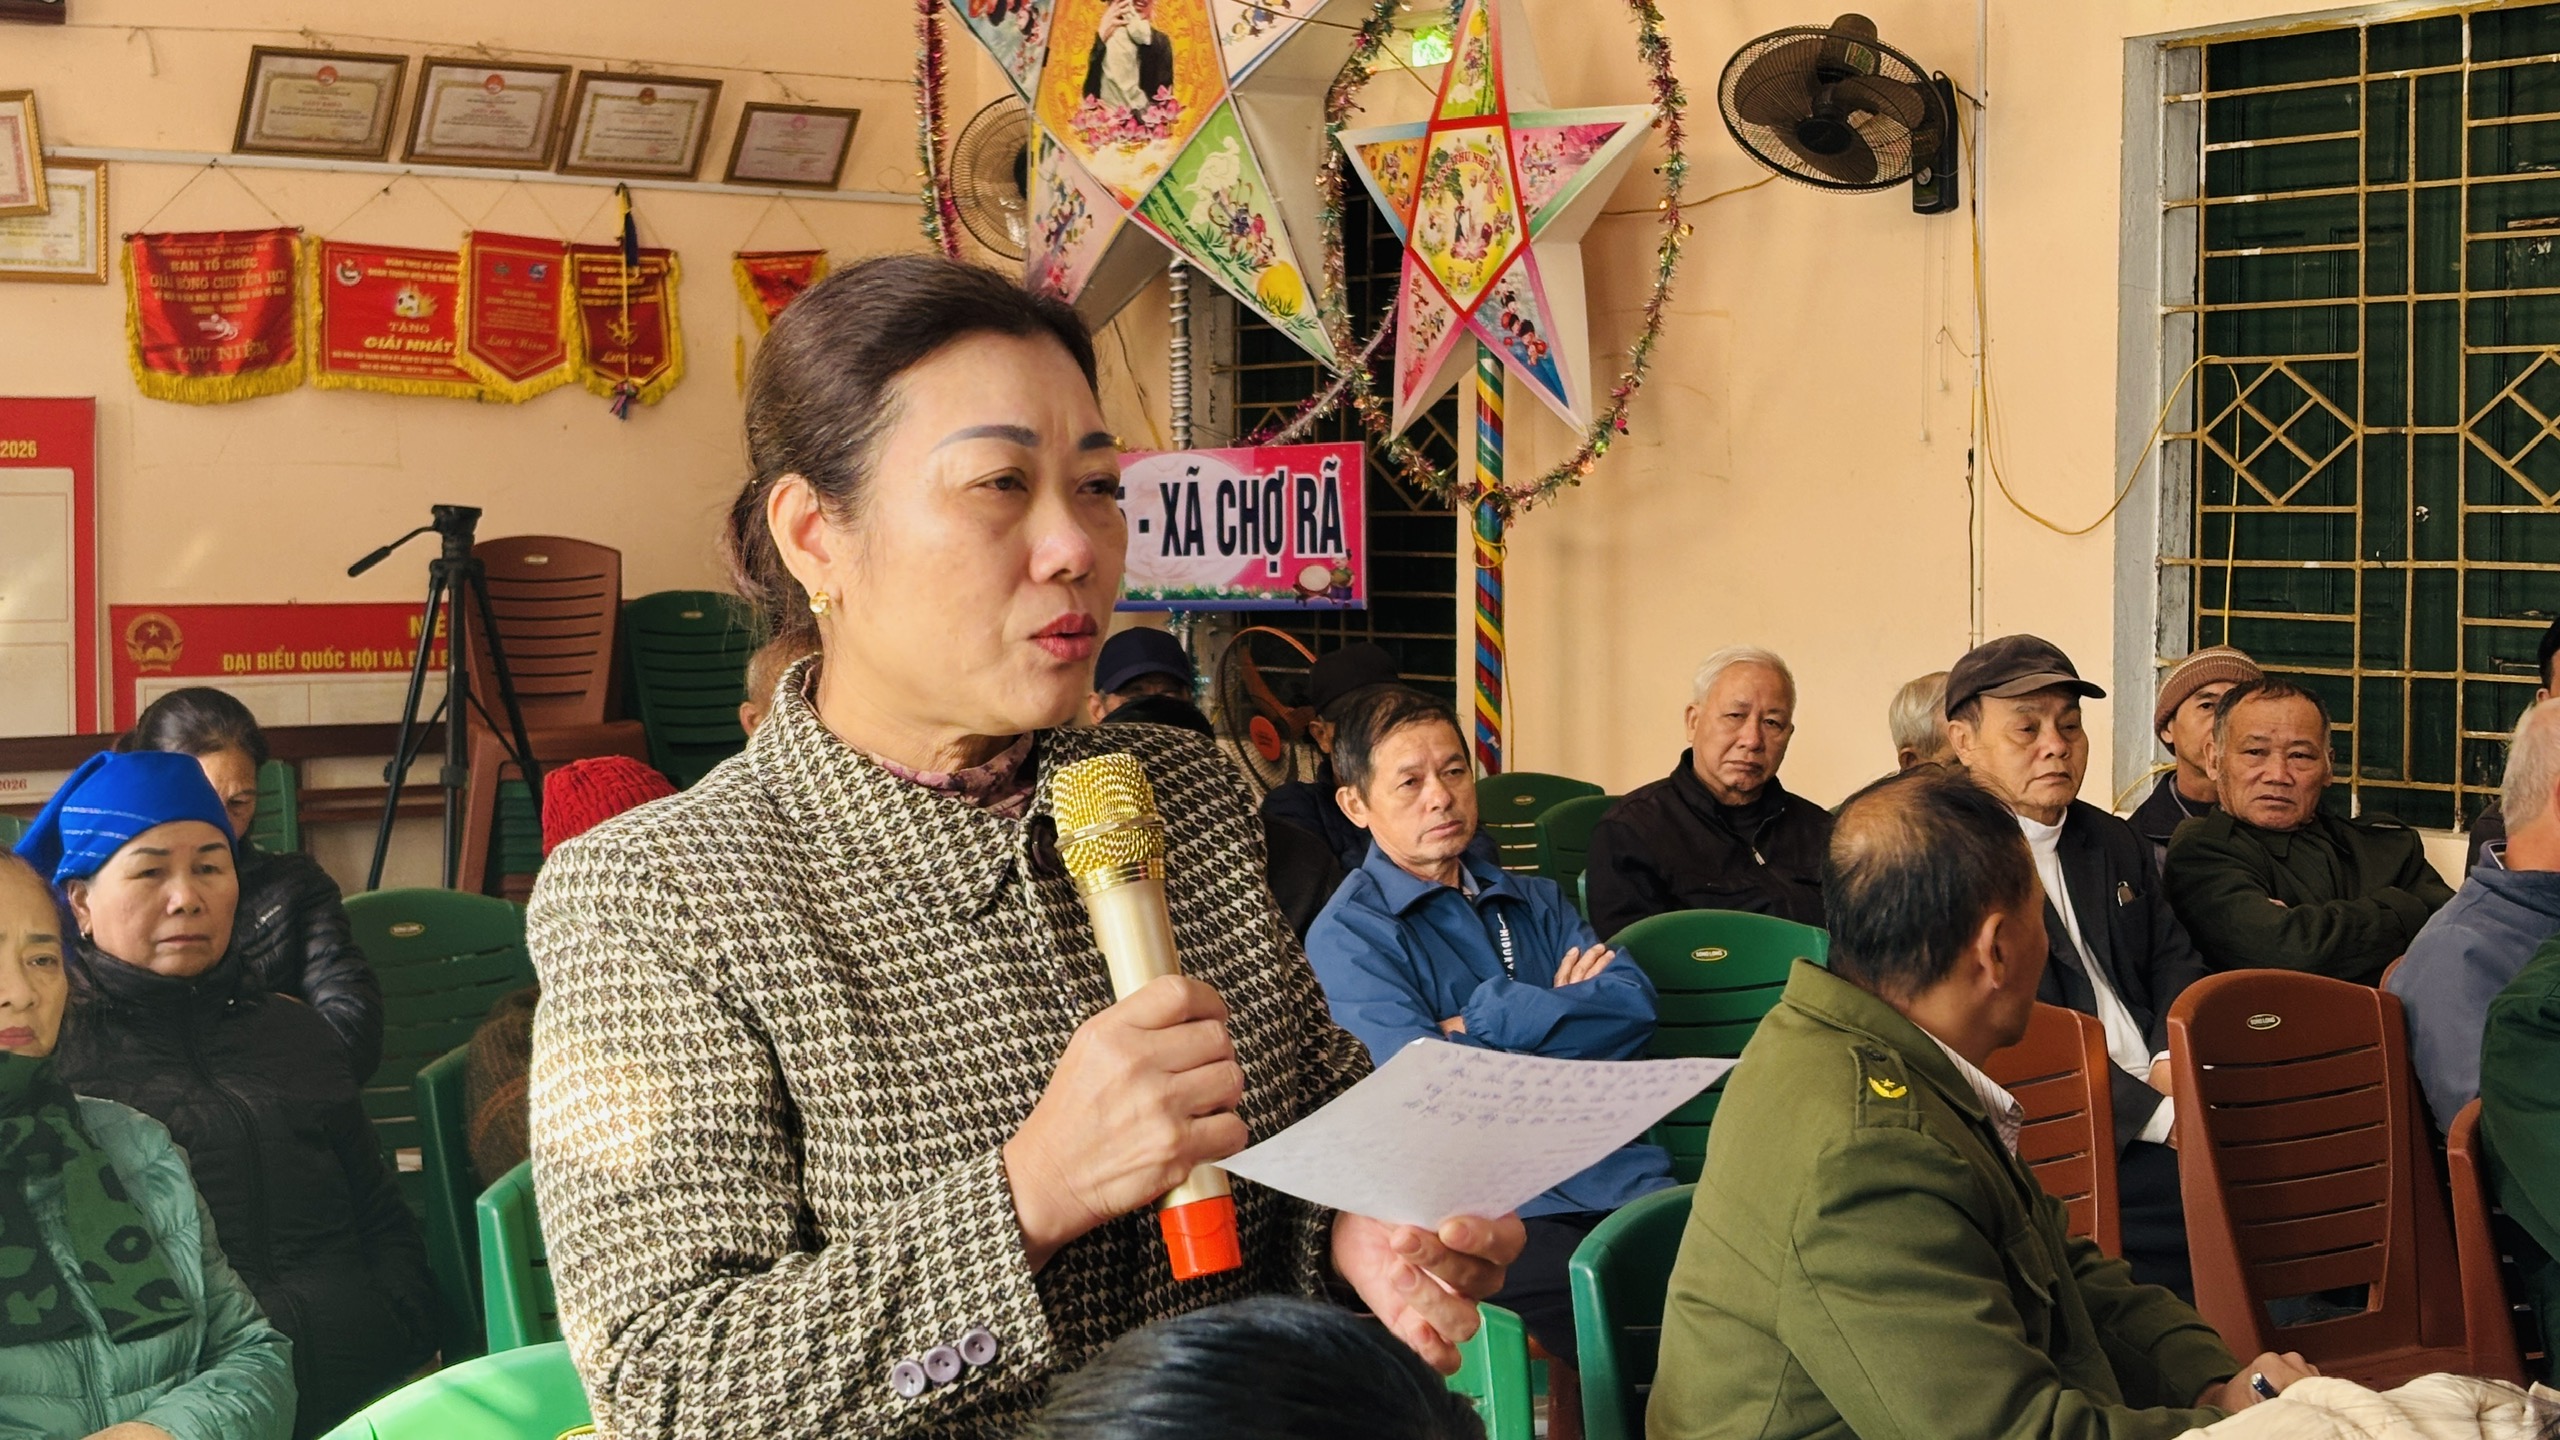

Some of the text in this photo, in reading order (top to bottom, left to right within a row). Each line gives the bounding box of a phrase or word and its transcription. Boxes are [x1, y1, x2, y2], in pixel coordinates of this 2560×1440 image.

[171, 260, 199, 272] BAN
[224, 255, 259, 269] CHỨC
[364, 334, 455, 354] GIẢI NHẤT
[0, 440, 37, 458] 2026
[1138, 460, 1343, 573] - XÃ CHỢ RÃ
[223, 653, 251, 675] ĐẠI
[257, 644, 296, 670] BIỂU
[301, 645, 345, 671] QUỐC
[351, 647, 378, 671] HỘI
[383, 646, 404, 668] VÀ
